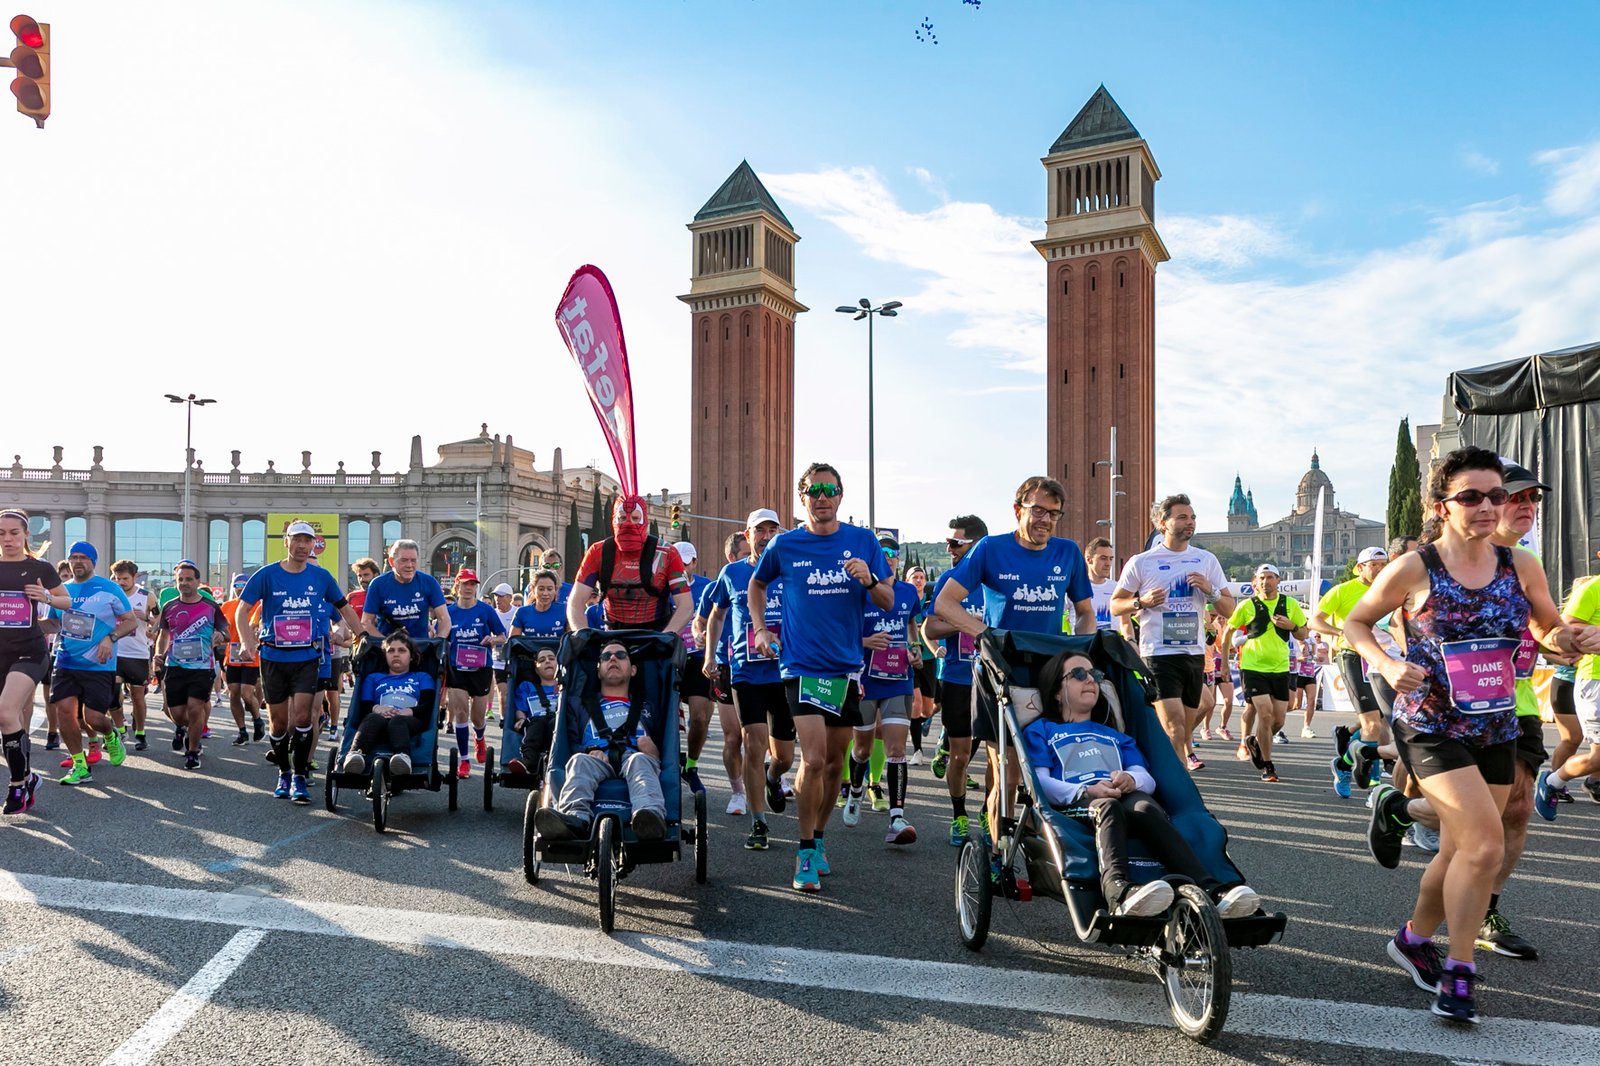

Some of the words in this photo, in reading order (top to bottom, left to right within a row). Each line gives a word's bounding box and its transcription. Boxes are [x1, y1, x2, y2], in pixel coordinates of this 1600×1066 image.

[792, 560, 813, 568] aefat
[998, 573, 1020, 581] aefat
[1047, 574, 1067, 582] ZURICH
[808, 587, 850, 596] #Imparables
[1013, 604, 1056, 613] #Imparables
[1471, 661, 1504, 674] DIANE
[1477, 676, 1503, 688] 4795
[816, 685, 832, 696] 7275
